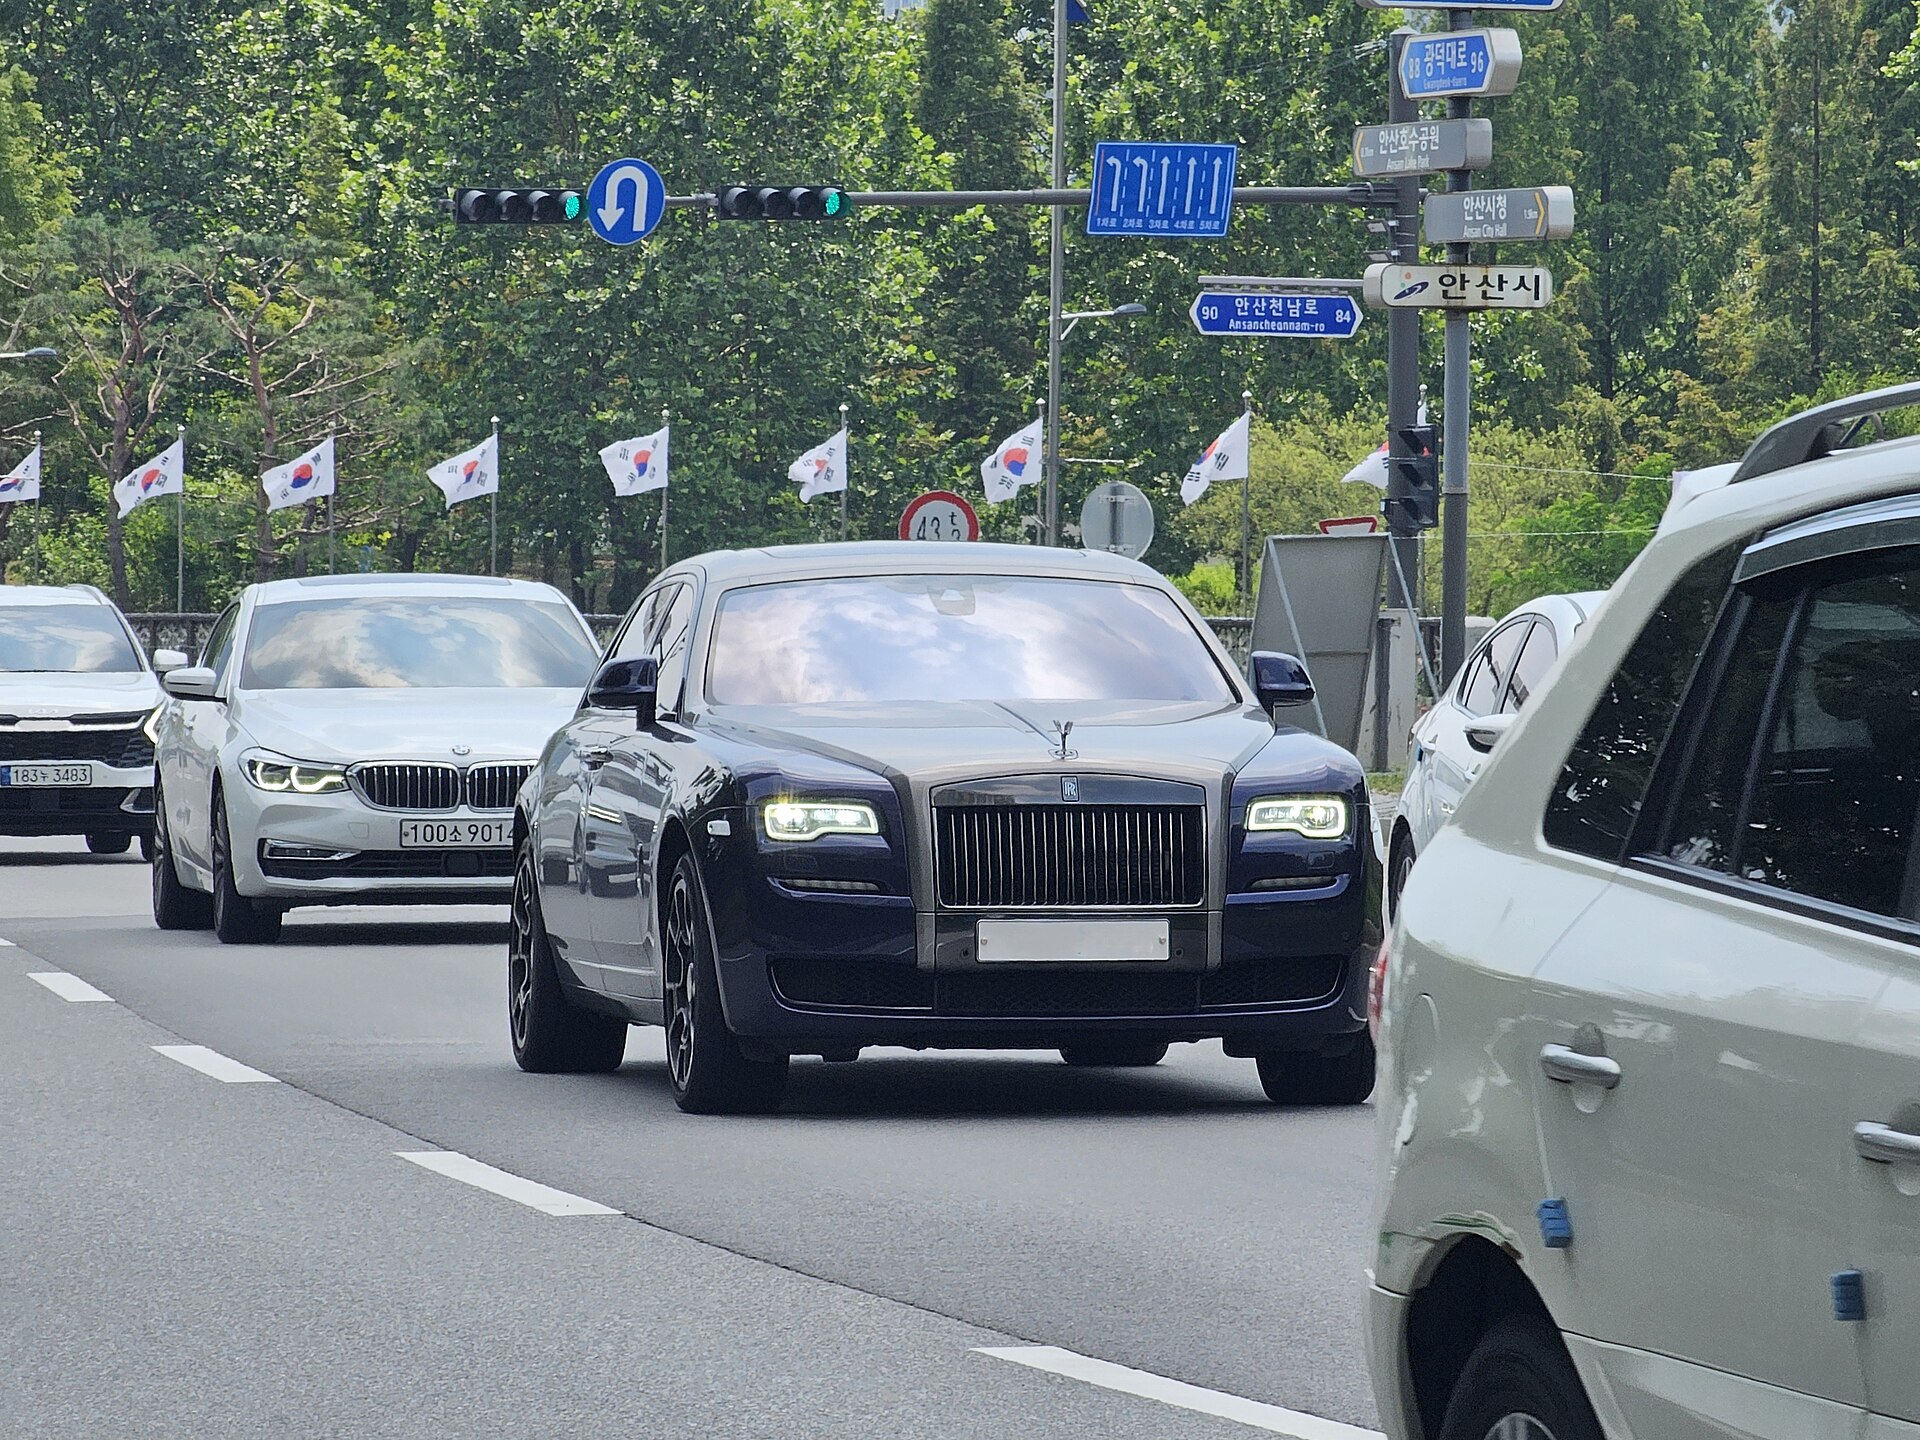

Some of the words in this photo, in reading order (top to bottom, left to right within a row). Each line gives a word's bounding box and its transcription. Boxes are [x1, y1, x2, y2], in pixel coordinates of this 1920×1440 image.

[1408, 57, 1420, 79] 88
[1423, 41, 1468, 77] 광덕대로
[1470, 50, 1484, 74] 96
[1378, 125, 1440, 154] 안산호수공원
[1463, 193, 1507, 221] 안산시청
[1122, 218, 1143, 229] 2차로
[1148, 219, 1169, 229] 3차로
[1173, 219, 1195, 230] 4차로
[1199, 220, 1220, 230] 5차로
[1438, 273, 1540, 301] 안산시
[1201, 306, 1218, 320] 90
[1234, 297, 1319, 318] 안산천남로
[1335, 309, 1351, 323] 84
[1228, 318, 1325, 332] Ansancheonnam-ro
[13, 769, 49, 783] 183누
[53, 768, 88, 783] 3483
[410, 824, 462, 842] 100소
